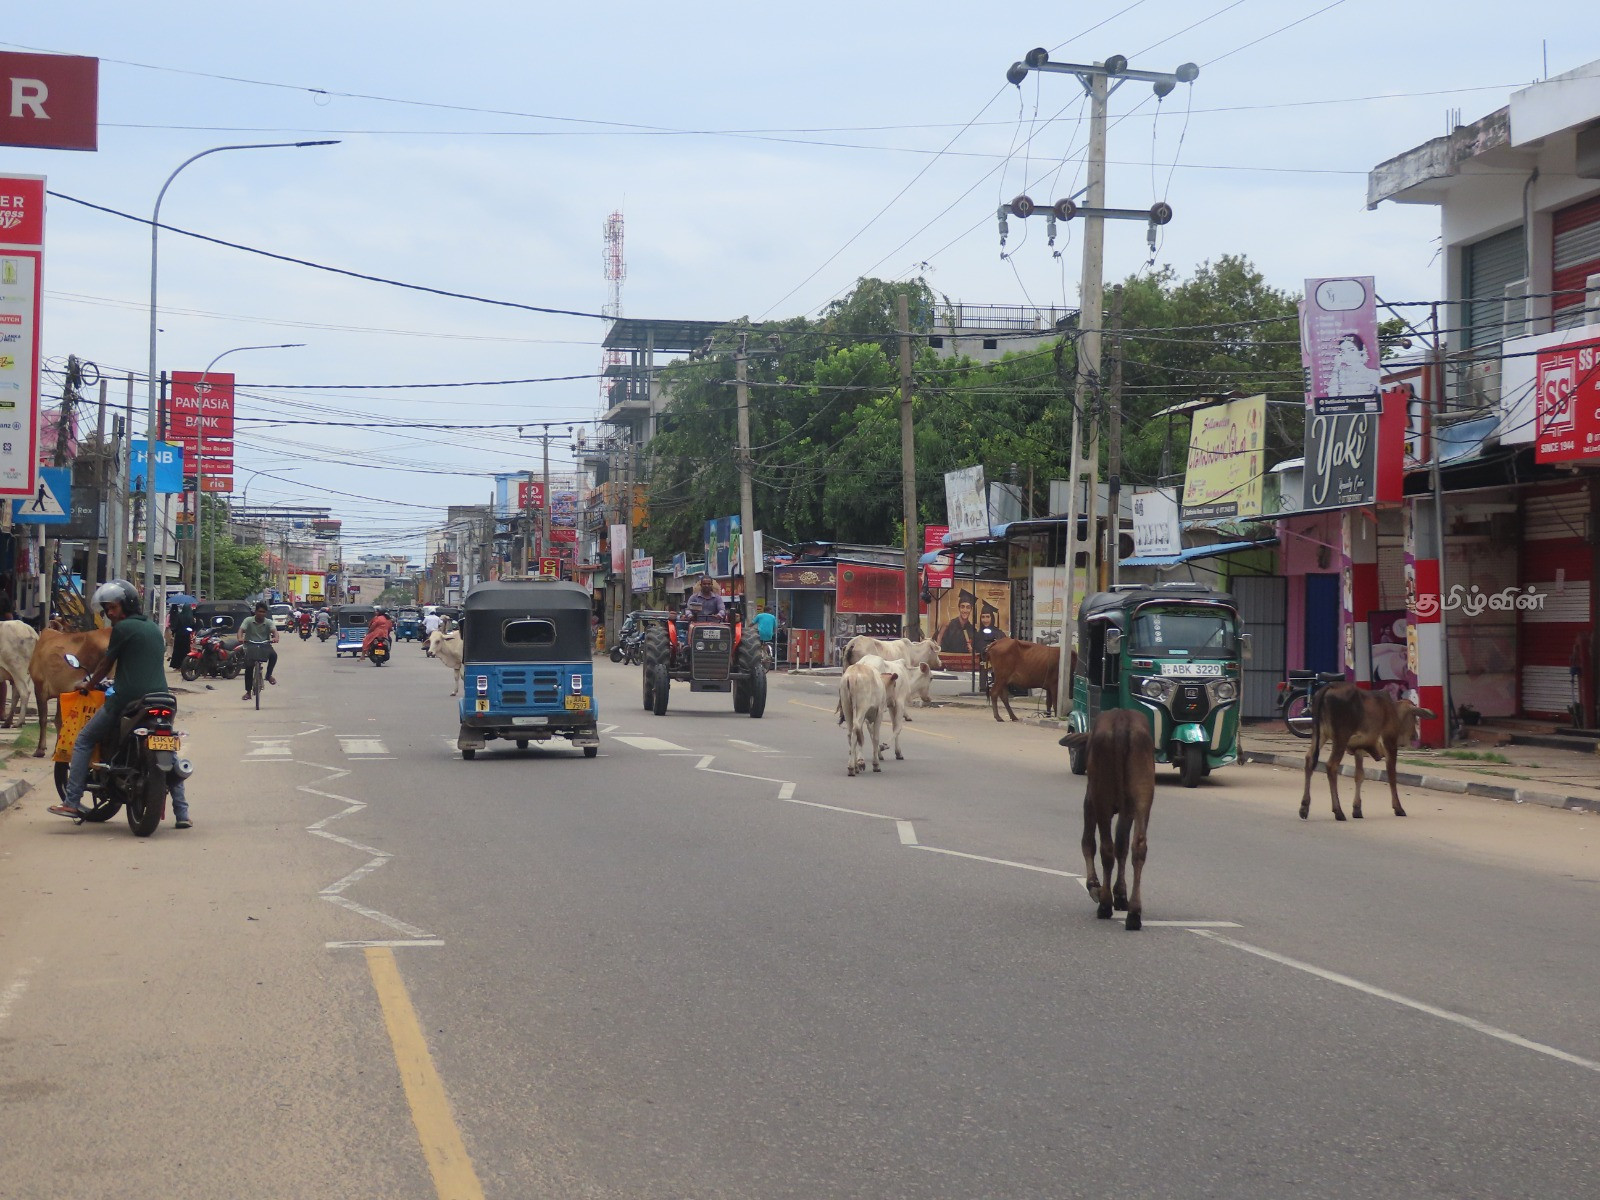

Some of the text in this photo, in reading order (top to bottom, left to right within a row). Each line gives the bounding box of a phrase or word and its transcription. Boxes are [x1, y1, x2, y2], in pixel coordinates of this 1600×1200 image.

[9, 77, 51, 119] R
[1578, 348, 1593, 371] SS
[1545, 378, 1569, 417] SS
[1540, 441, 1575, 453] SINCE 1944
[209, 478, 225, 488] ria
[1172, 665, 1191, 675] ABK
[1195, 665, 1220, 675] 3229
